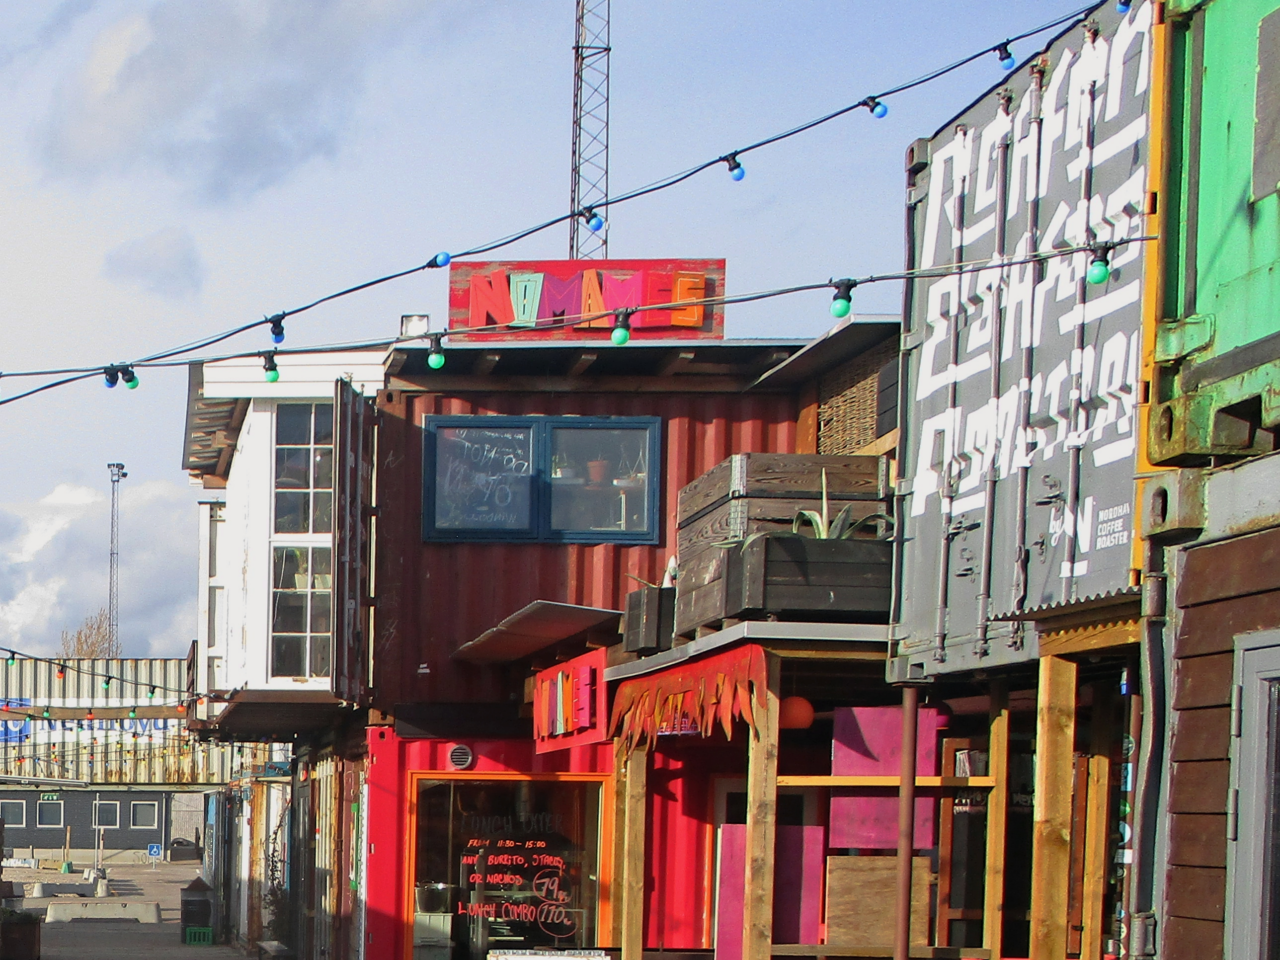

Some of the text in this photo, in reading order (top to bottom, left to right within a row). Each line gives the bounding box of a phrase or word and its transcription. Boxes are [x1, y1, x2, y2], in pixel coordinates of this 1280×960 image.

[469, 268, 706, 329] NOMAMES
[1097, 519, 1124, 536] COFFEE
[525, 840, 546, 848] 15:00
[461, 855, 479, 864] ANY
[469, 874, 483, 883] OR
[458, 901, 496, 918] LUNCH
[501, 903, 536, 921] COMBO
